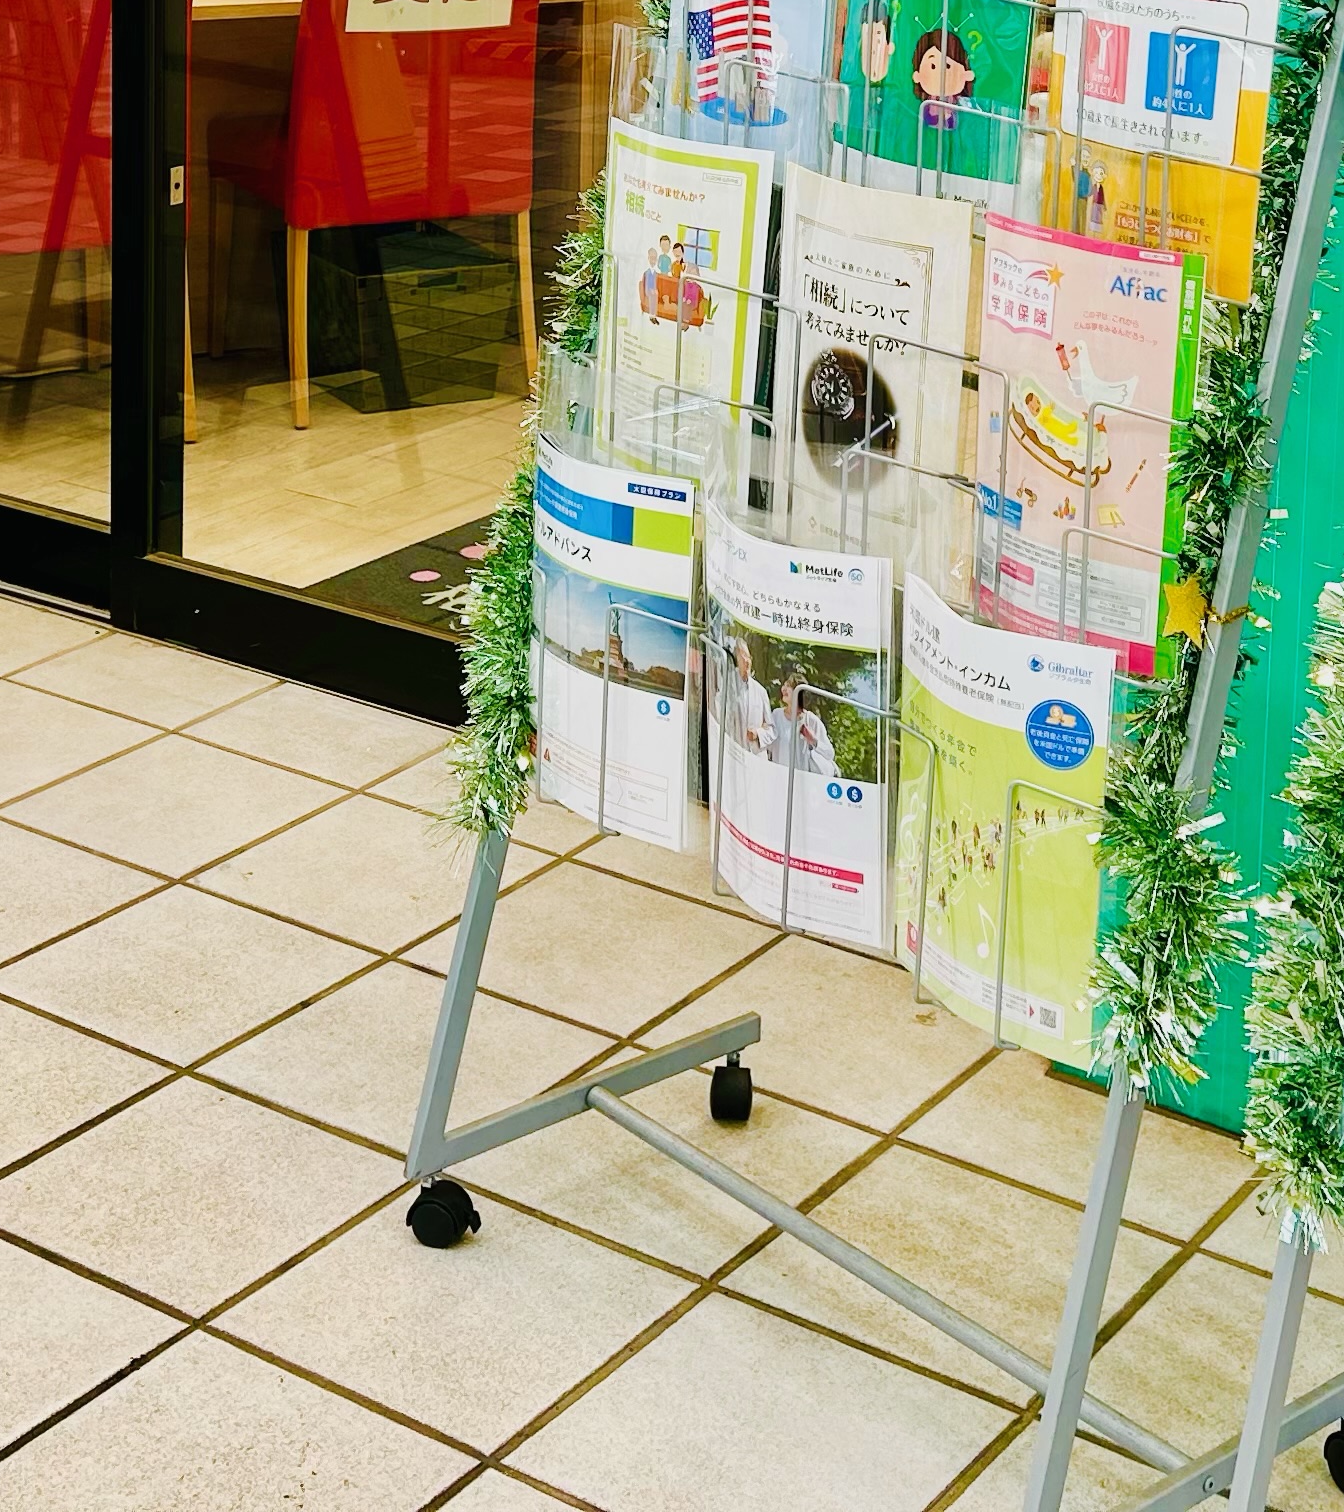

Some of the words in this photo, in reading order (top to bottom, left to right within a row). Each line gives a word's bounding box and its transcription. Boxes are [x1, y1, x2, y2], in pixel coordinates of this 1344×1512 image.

[803, 273, 910, 327] 「相続」について
[1048, 661, 1093, 678] Gibraltar
